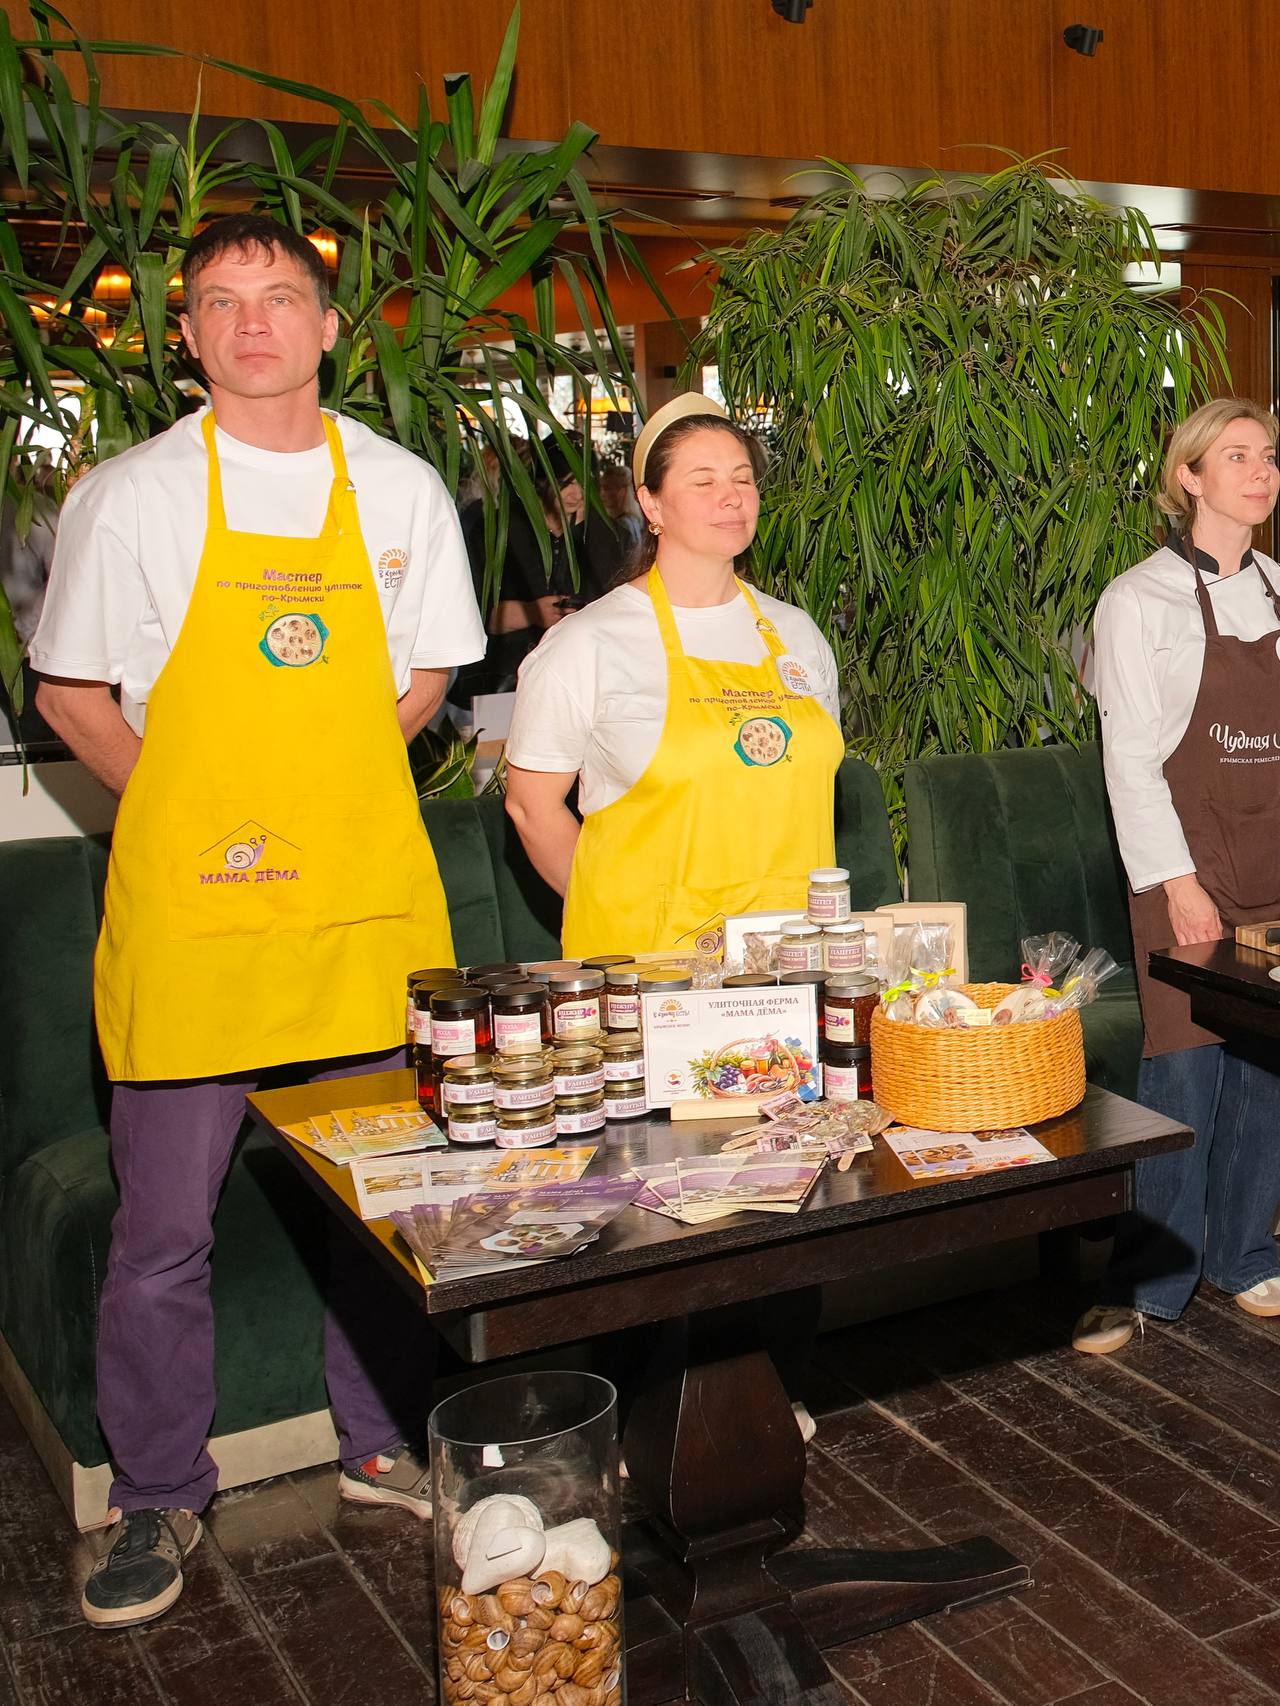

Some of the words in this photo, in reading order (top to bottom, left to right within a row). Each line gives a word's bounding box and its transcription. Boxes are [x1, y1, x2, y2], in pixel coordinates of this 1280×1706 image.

[263, 568, 322, 584] Мастер
[216, 580, 231, 588] по
[235, 581, 322, 592] приготовлению
[324, 582, 363, 593] улиток
[262, 594, 325, 603] по-Крымски
[722, 688, 774, 697] Мастер
[1209, 722, 1270, 753] Чудная
[199, 872, 250, 885] МАМА
[254, 868, 300, 883] ДЁМА
[708, 998, 765, 1009] УЛИТОЧНАЯ
[766, 997, 799, 1007] ФЕРМА
[721, 1008, 754, 1018] «МАМА
[756, 1006, 787, 1017] ДЁМА»
[567, 1078, 594, 1088] УЛИТКИ
[511, 1093, 541, 1102] УЛИТКИ
